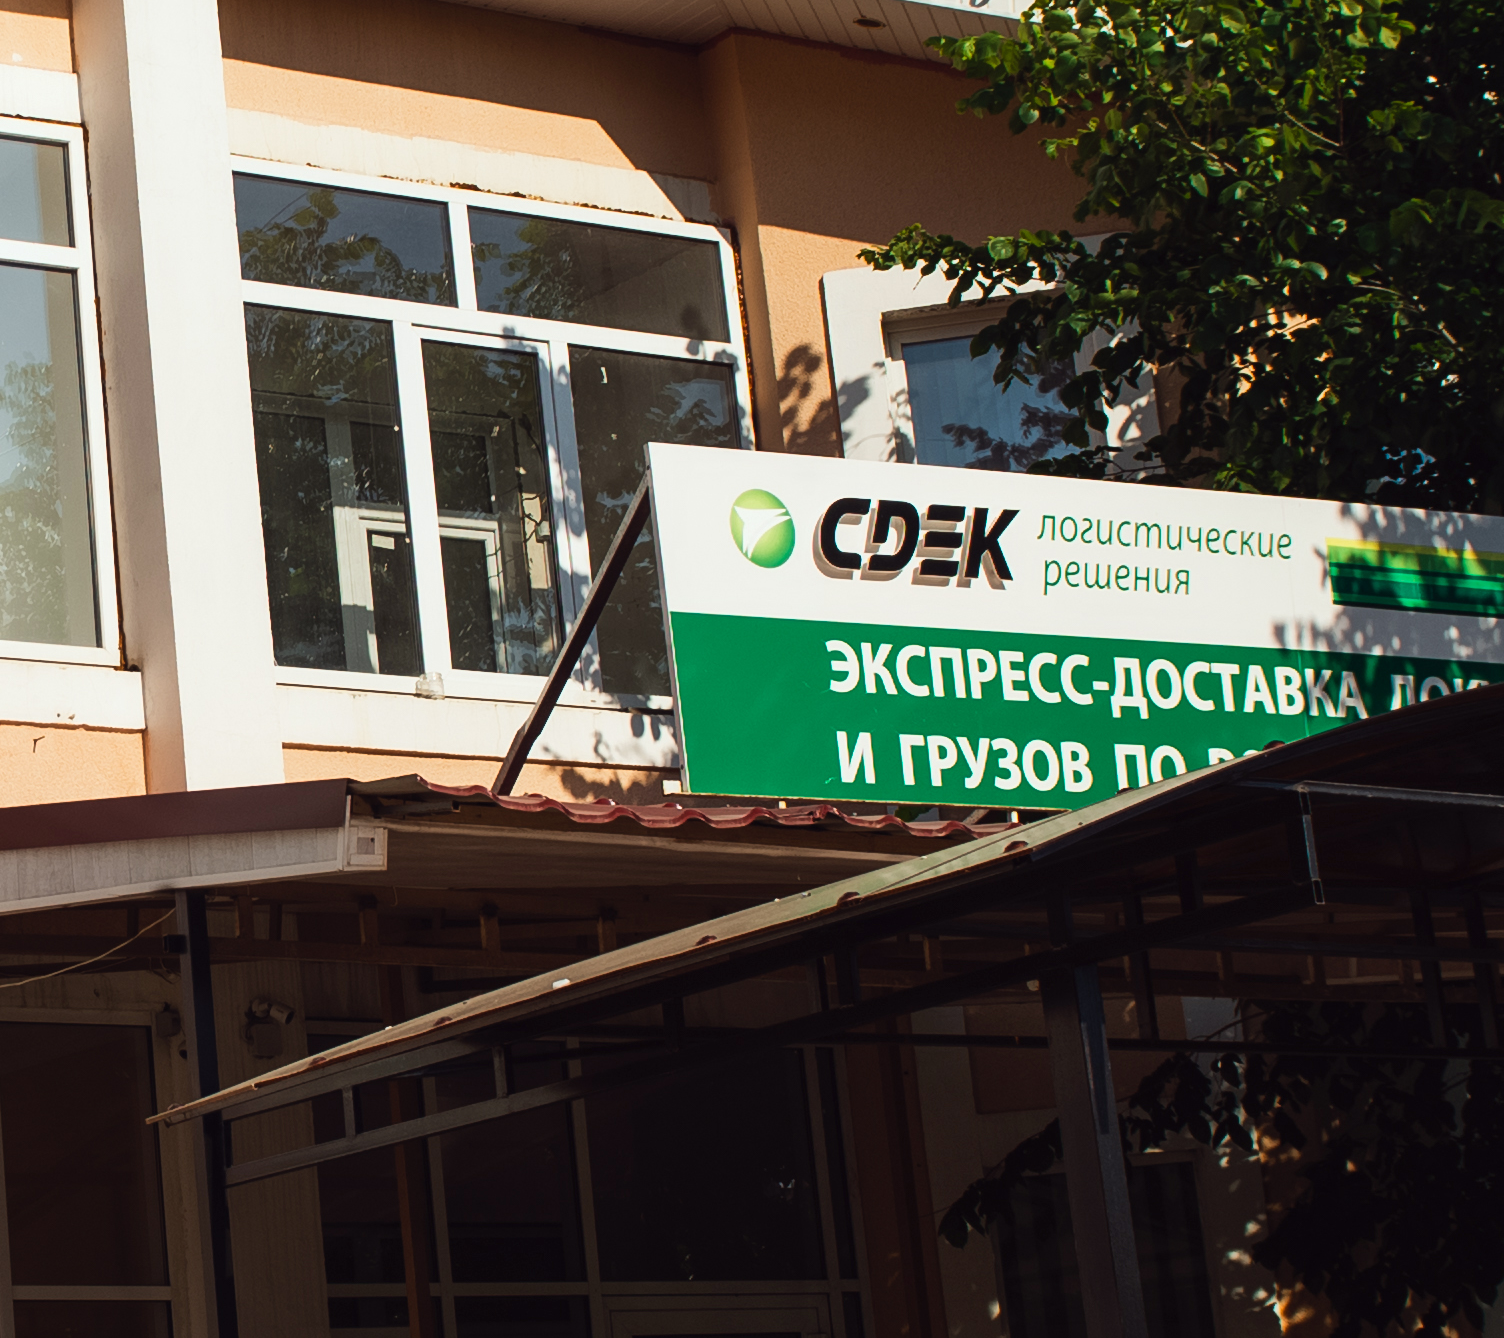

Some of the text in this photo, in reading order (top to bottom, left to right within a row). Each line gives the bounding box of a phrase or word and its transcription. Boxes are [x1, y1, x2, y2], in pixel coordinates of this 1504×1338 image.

[818, 497, 1020, 583] CDEK
[1037, 514, 1292, 560] логистические
[1043, 560, 1190, 597] решения
[825, 639, 1368, 721] ЭКСПРЕСС-ДОСТАВКА
[836, 730, 1187, 793] И ГРУЗОВ ПО
